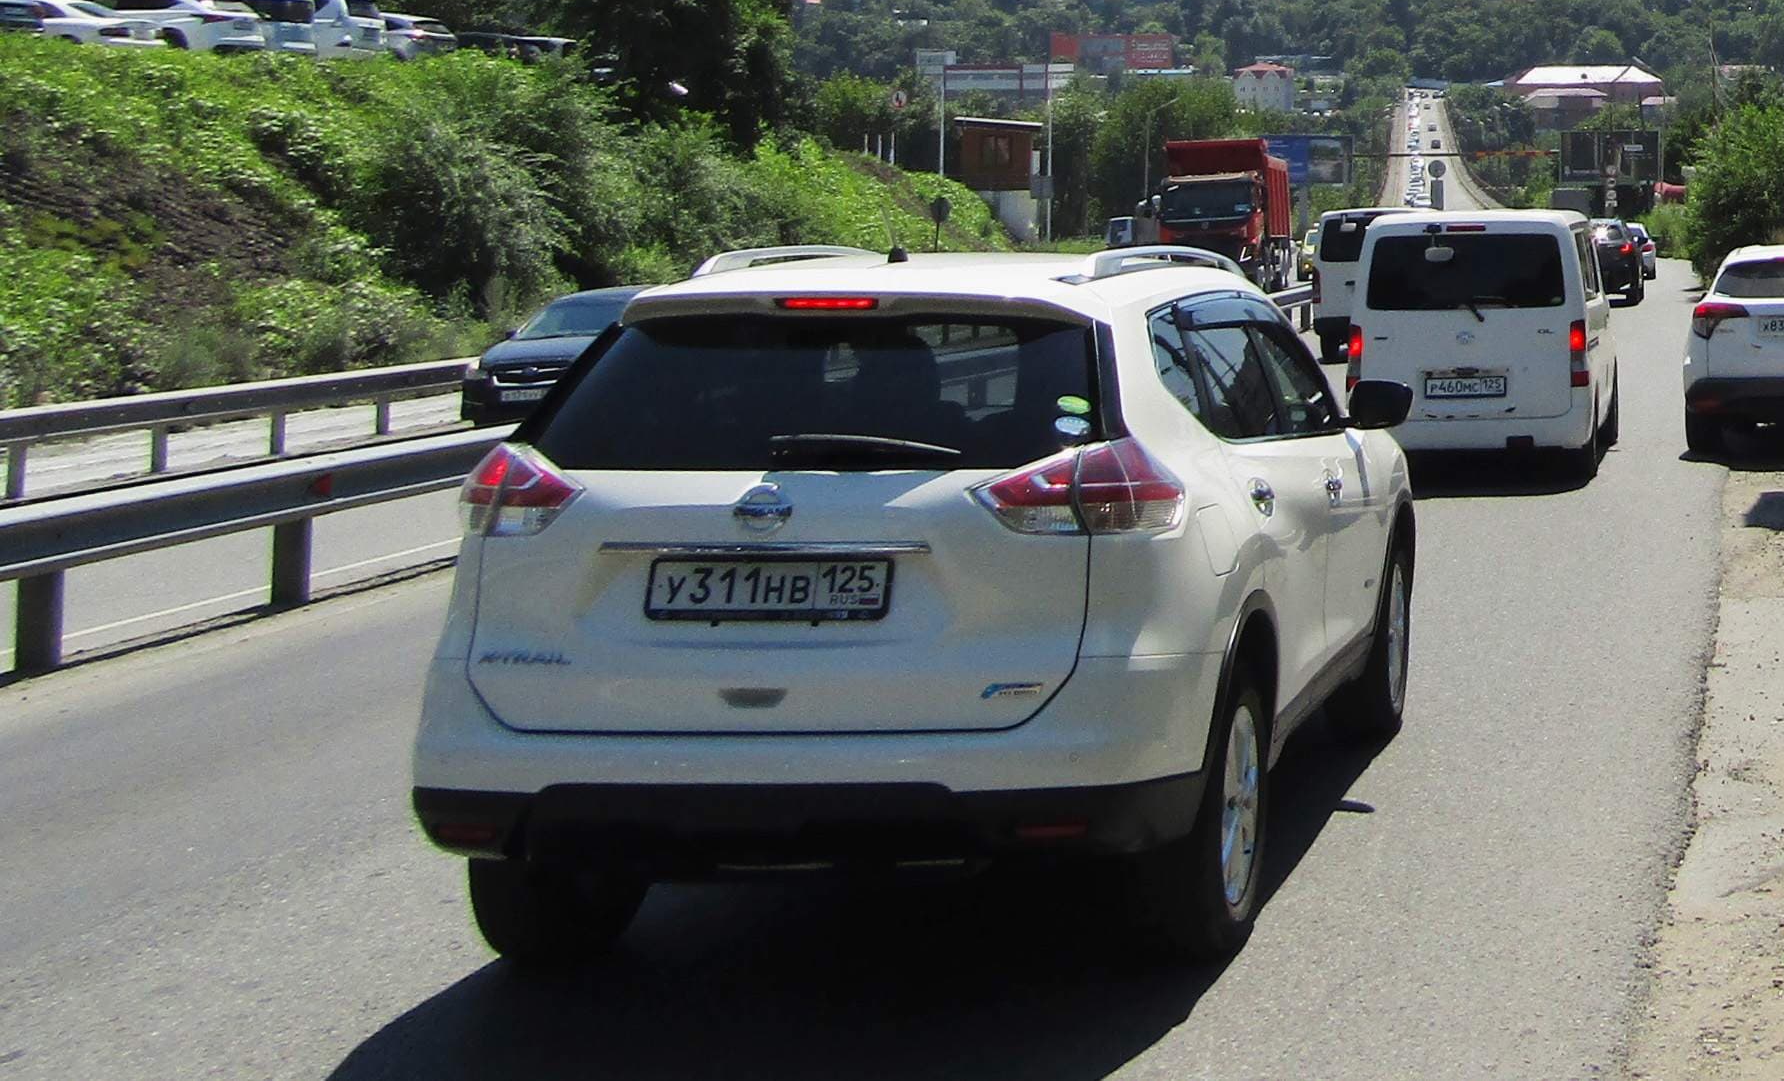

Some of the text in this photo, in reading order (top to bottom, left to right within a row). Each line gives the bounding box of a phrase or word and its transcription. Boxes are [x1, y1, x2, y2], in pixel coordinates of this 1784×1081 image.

[1430, 379, 1502, 393] Р460МС 125
[666, 565, 874, 604] У311НВ 125
[829, 595, 859, 605] RUS
